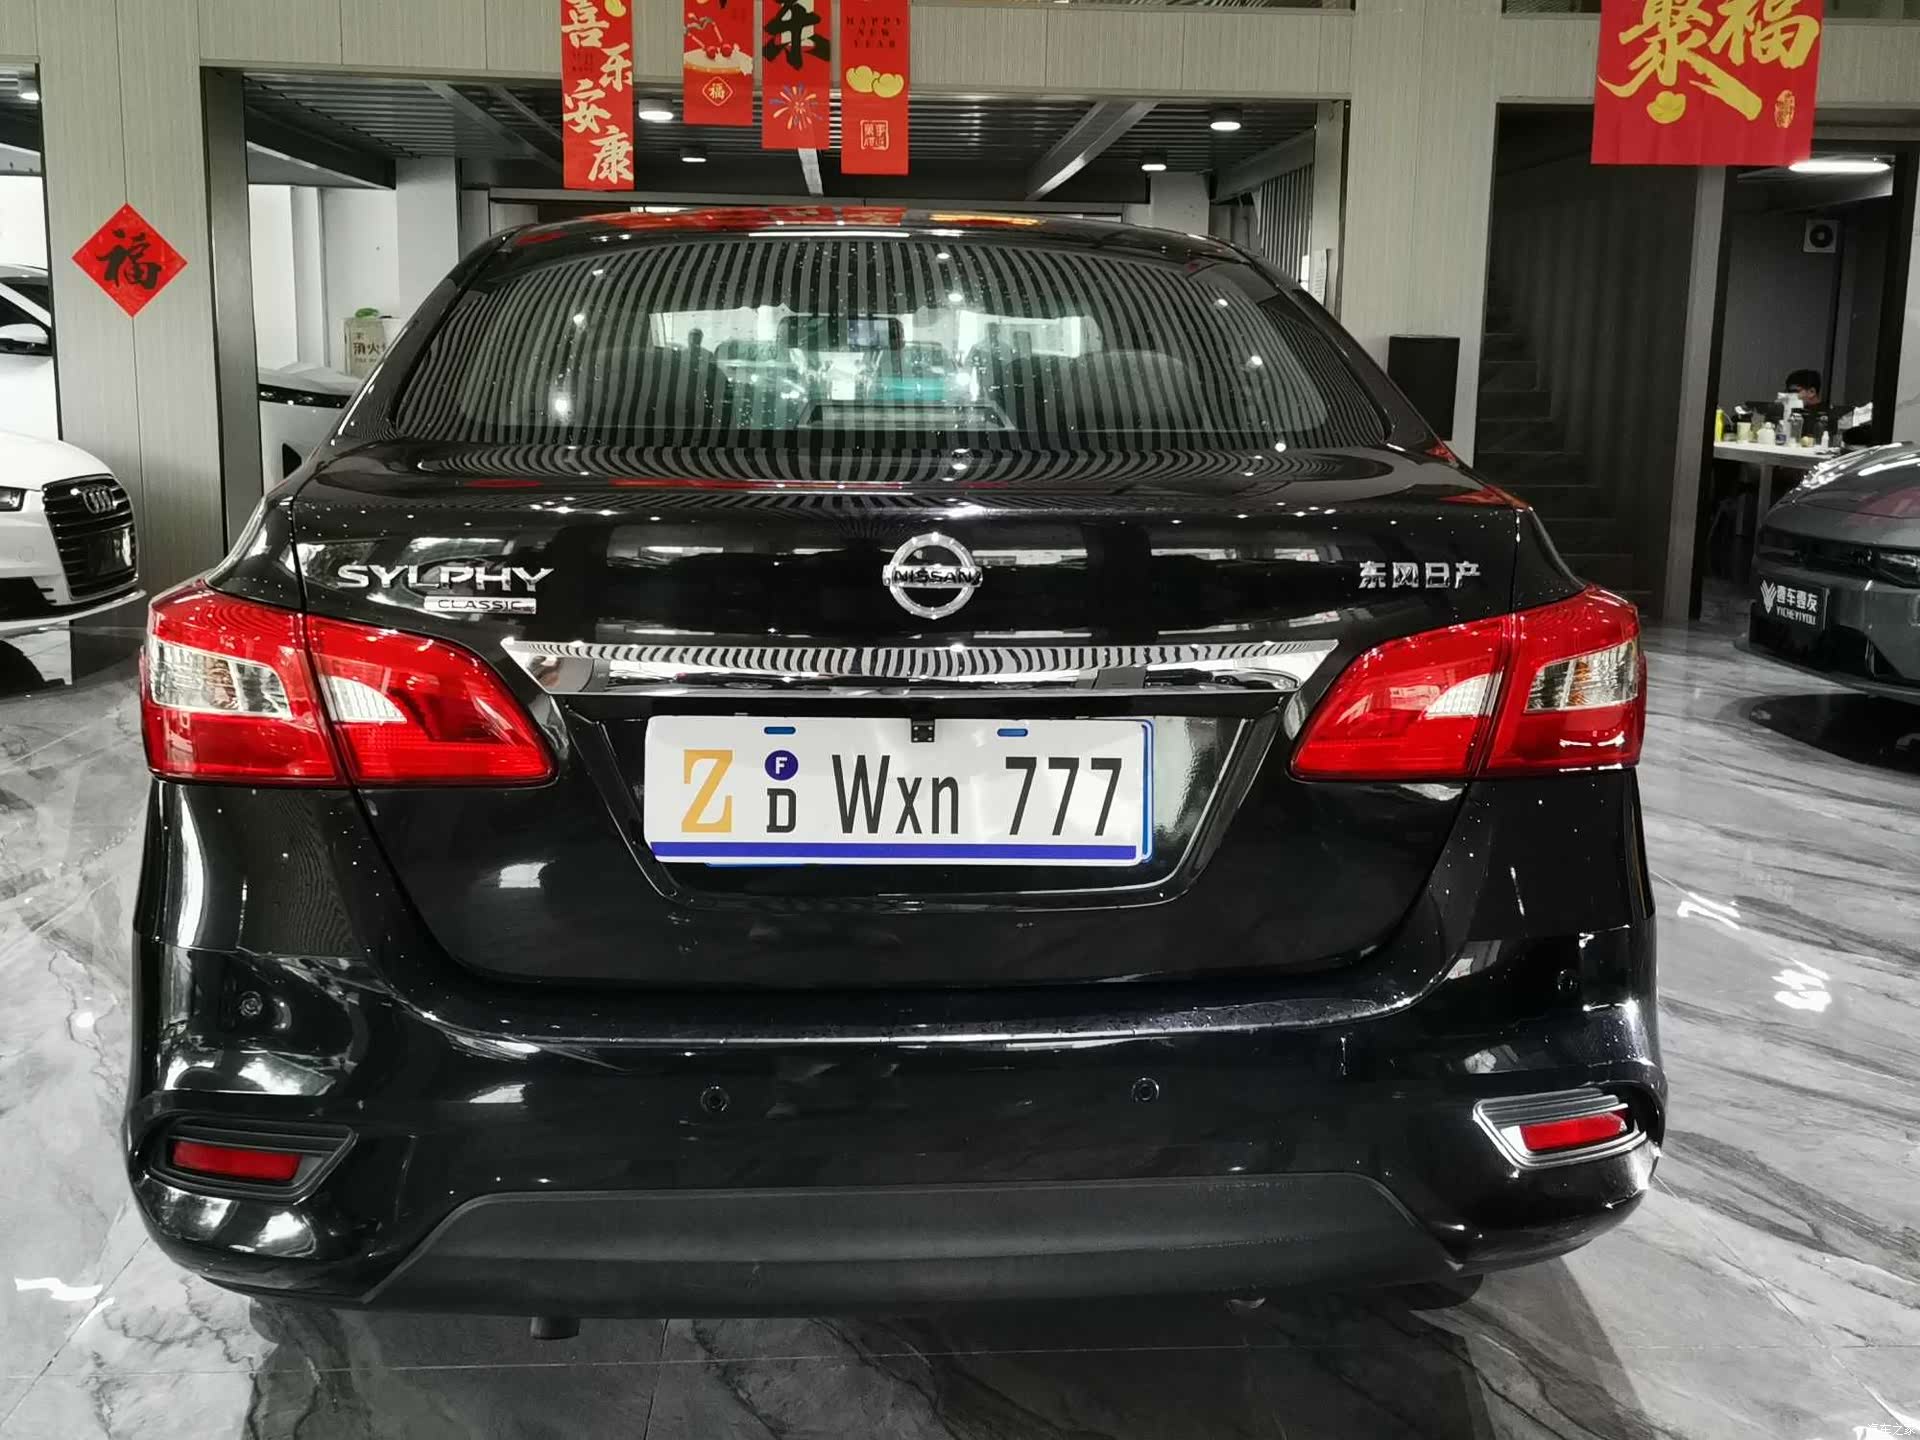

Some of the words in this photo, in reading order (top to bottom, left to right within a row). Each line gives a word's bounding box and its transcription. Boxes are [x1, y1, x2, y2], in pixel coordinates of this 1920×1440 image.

[96, 228, 162, 290] 福
[337, 564, 554, 592] SYLPHY
[892, 568, 975, 585] NISSAN
[1359, 560, 1480, 589] 东风日产
[438, 599, 522, 611] CLASSIC
[775, 757, 788, 774] F
[681, 749, 733, 833] Z
[766, 788, 797, 833] D
[831, 754, 960, 834] Wxn
[1004, 757, 1123, 836] 777
